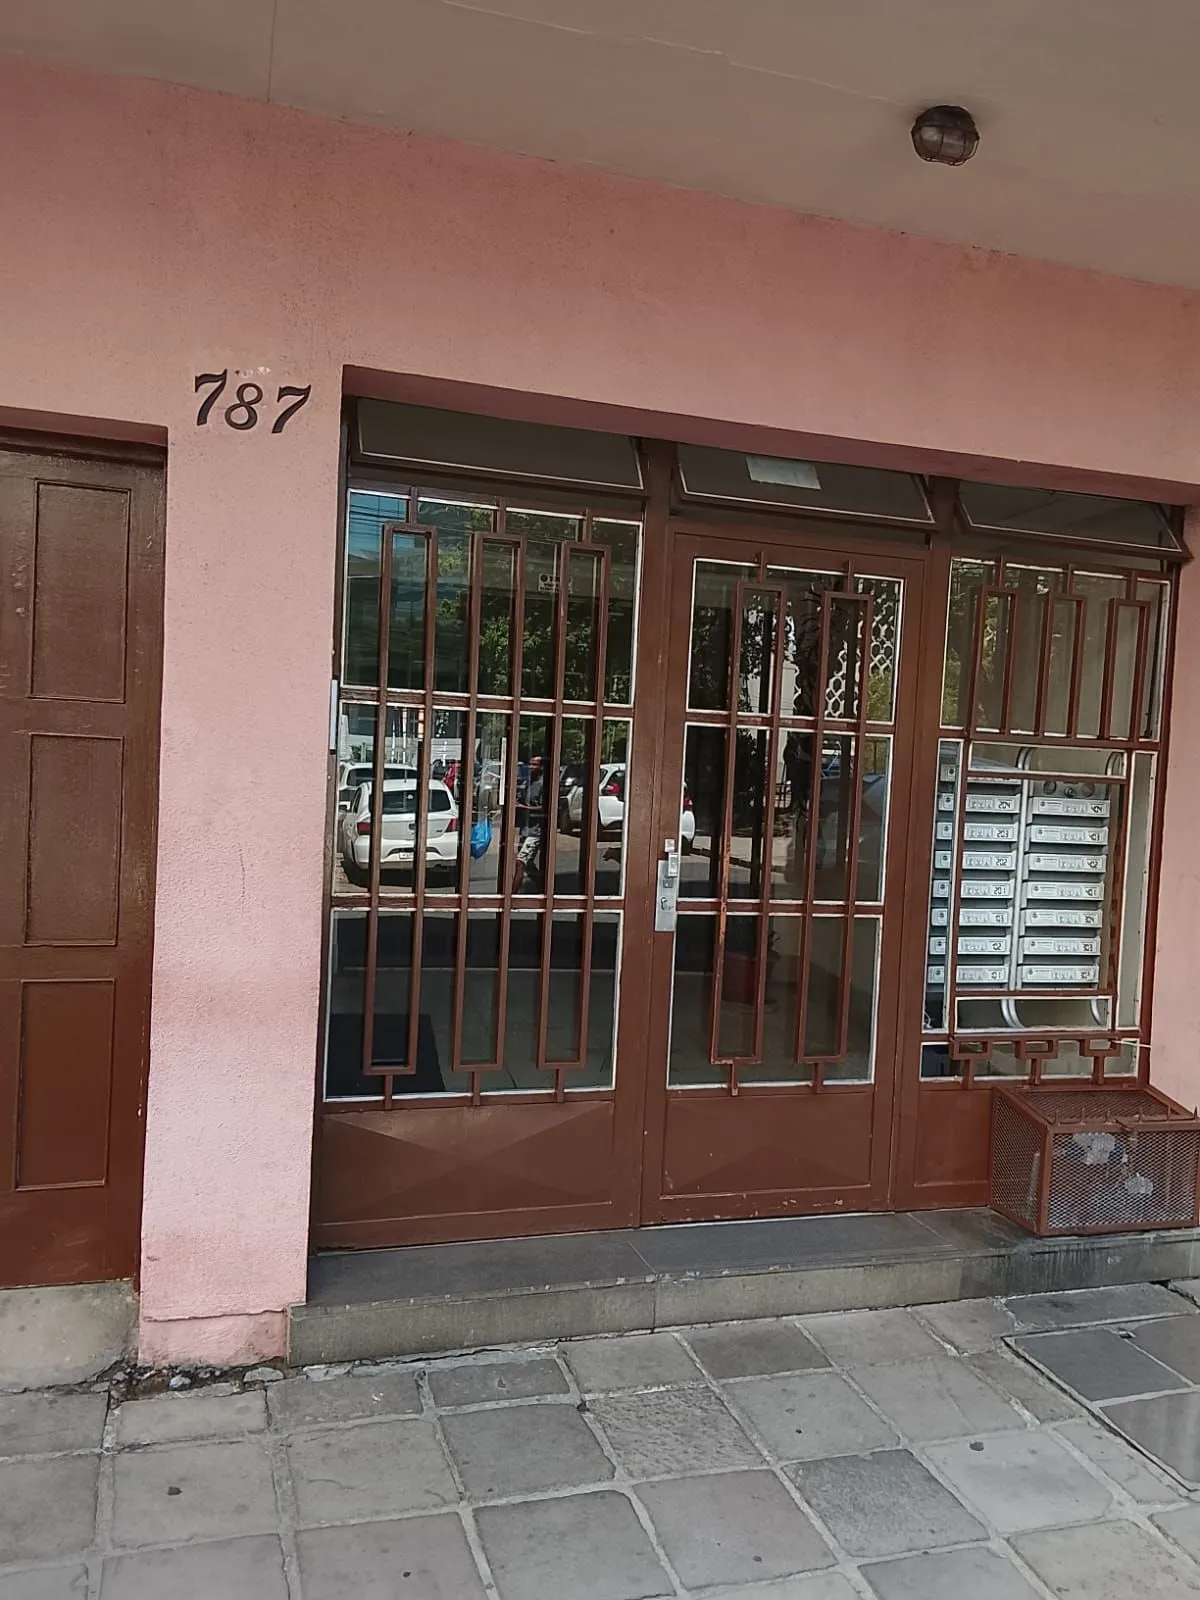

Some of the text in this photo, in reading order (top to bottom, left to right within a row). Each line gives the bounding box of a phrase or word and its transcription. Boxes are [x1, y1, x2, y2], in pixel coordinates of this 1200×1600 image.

[195, 368, 311, 434] 787
[995, 857, 1008, 867] 202
[993, 886, 1006, 895] 201
